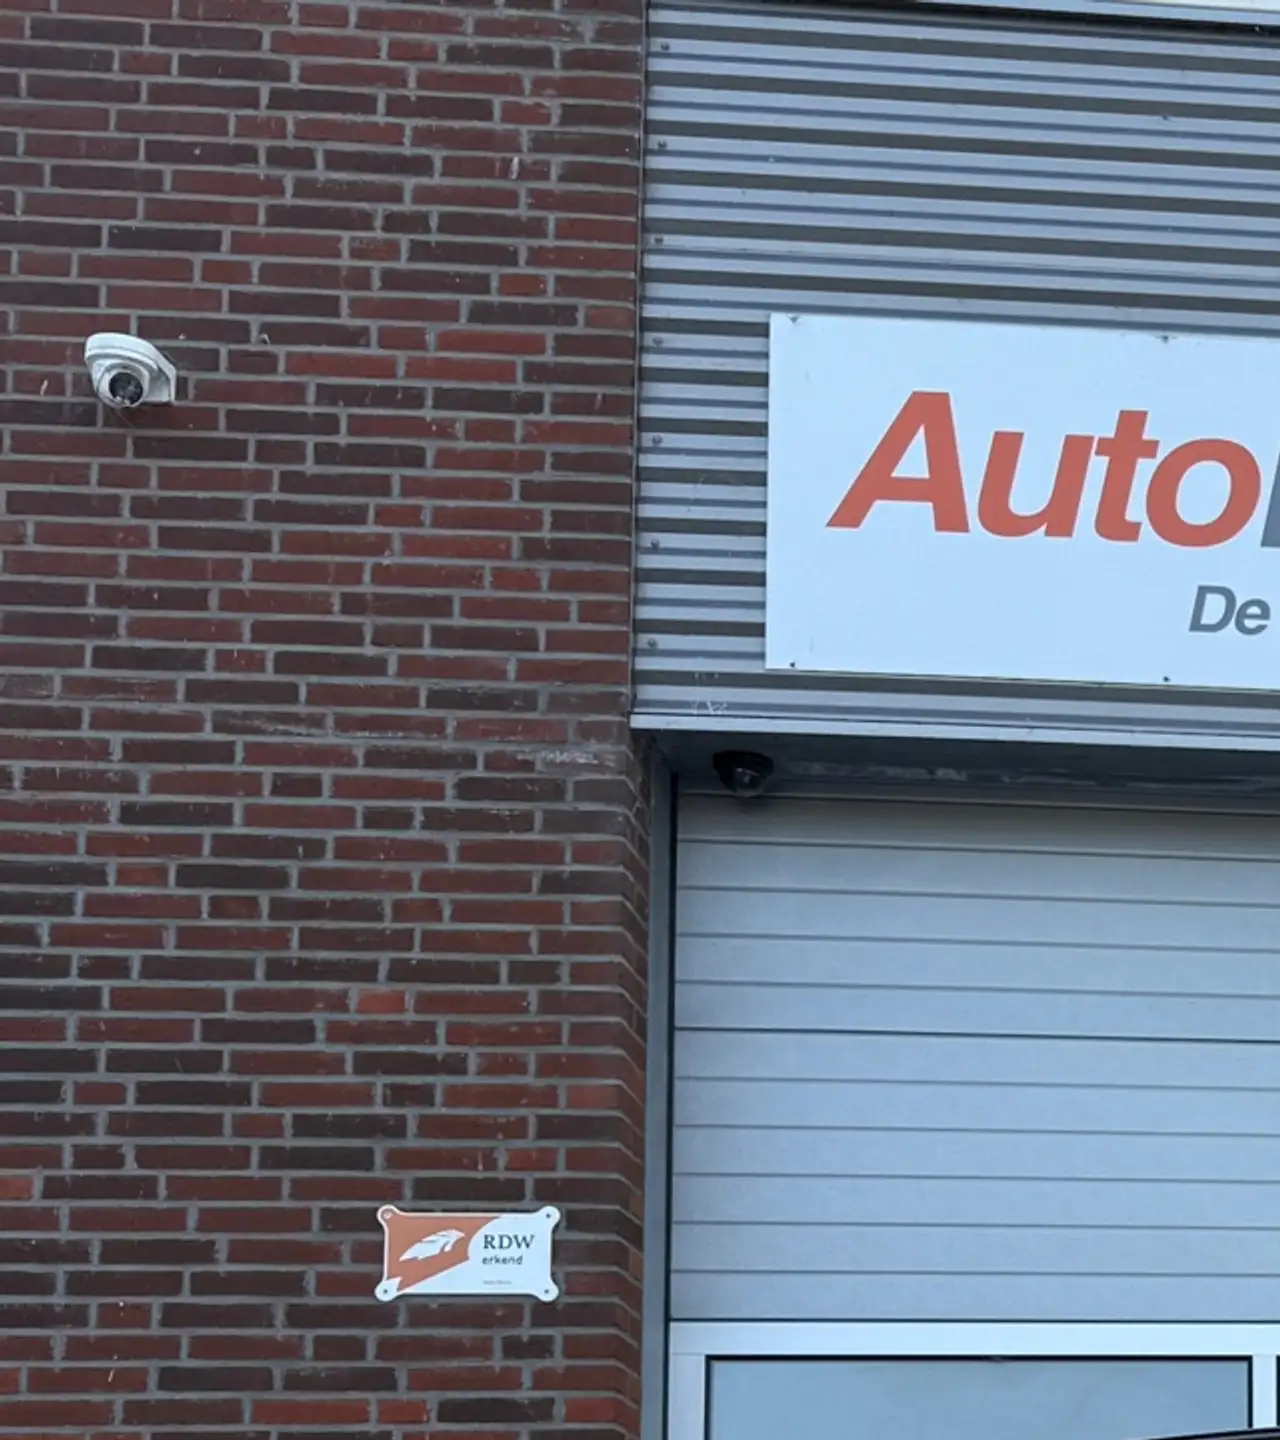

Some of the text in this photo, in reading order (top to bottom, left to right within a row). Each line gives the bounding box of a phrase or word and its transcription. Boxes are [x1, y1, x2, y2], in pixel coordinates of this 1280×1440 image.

[1189, 584, 1271, 636] De
[484, 1234, 535, 1249] RDW
[482, 1255, 523, 1265] erkend
